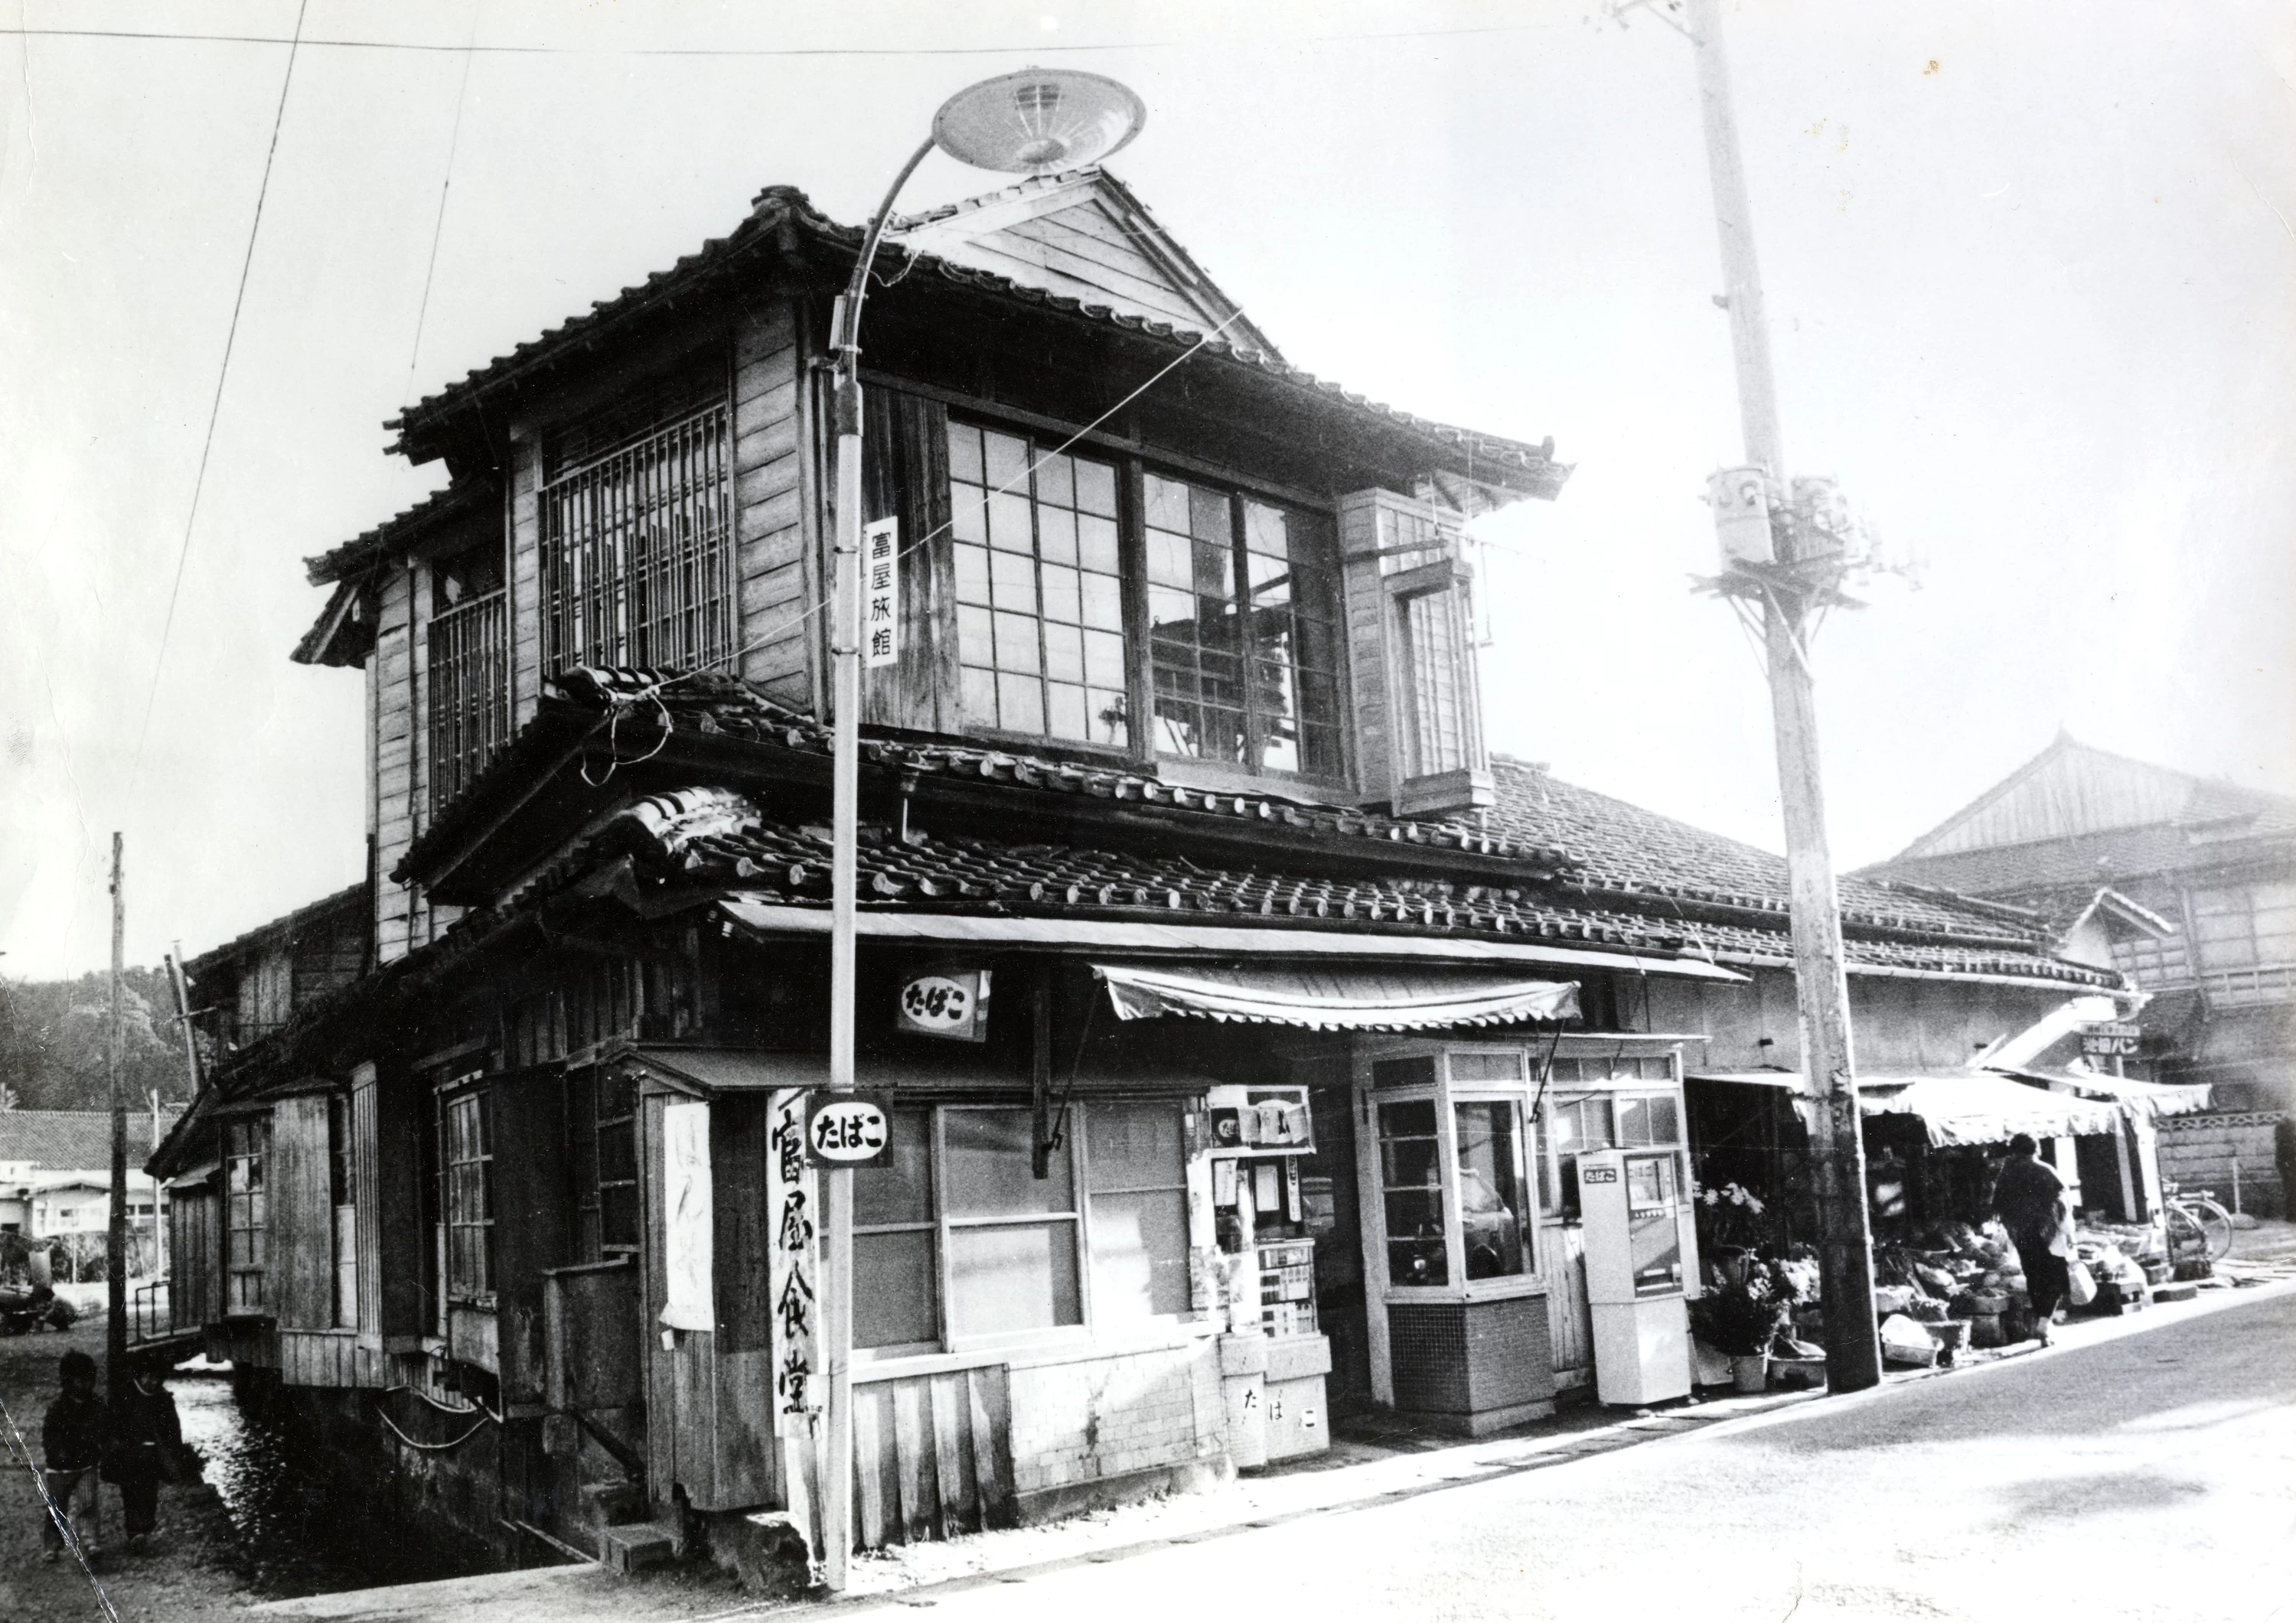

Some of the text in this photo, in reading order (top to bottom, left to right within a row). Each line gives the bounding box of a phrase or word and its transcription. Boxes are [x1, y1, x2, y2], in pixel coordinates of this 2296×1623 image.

[871, 532, 891, 657] 富屋旅館
[906, 984, 965, 1020] たばこ
[817, 1113, 882, 1149] たばこ
